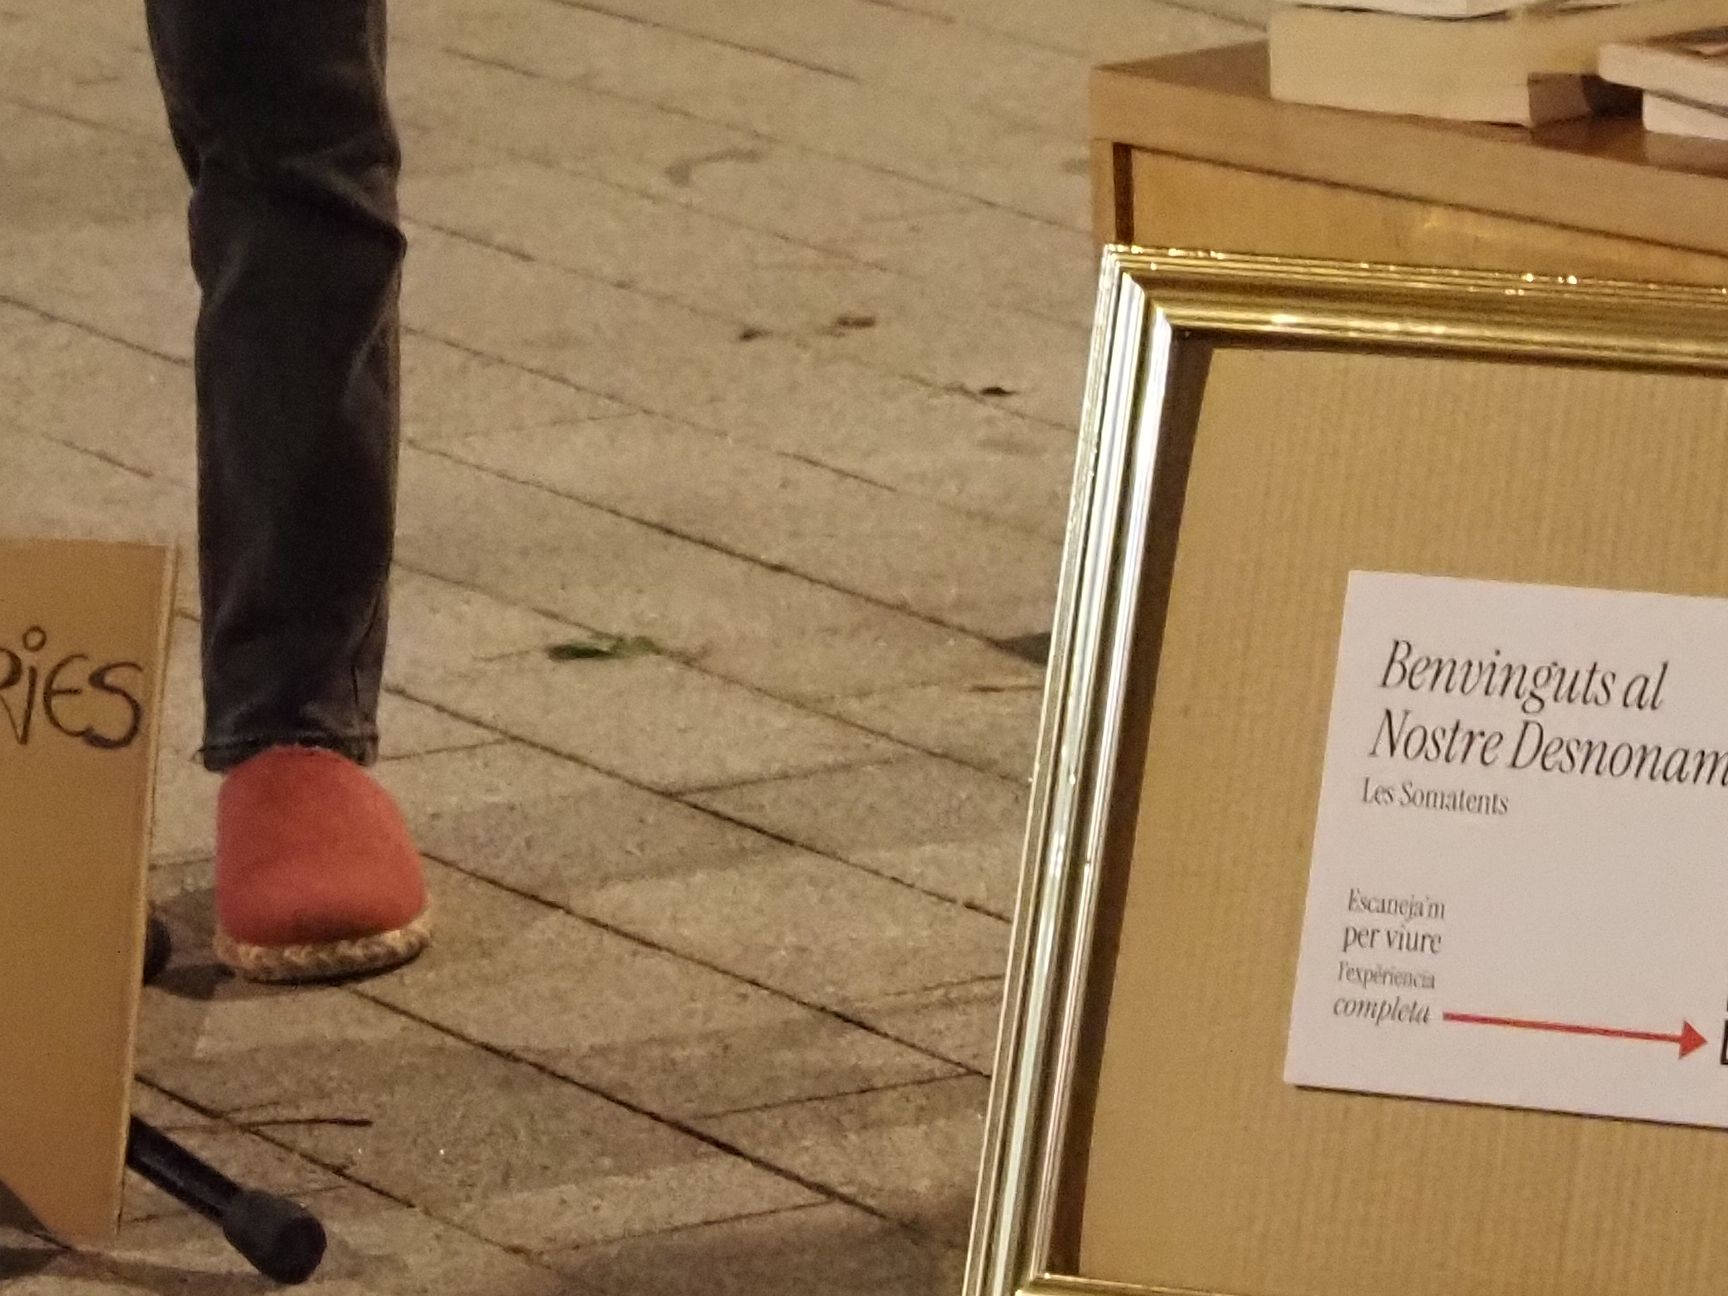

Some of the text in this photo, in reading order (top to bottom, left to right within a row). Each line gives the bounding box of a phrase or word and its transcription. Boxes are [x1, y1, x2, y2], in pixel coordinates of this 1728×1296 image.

[1379, 638, 1670, 714] Benvinguts al
[1369, 708, 1504, 767] Nostre
[1362, 776, 1510, 816] Les Somatents
[1342, 924, 1442, 954] per viure
[1333, 996, 1430, 1027] completa
